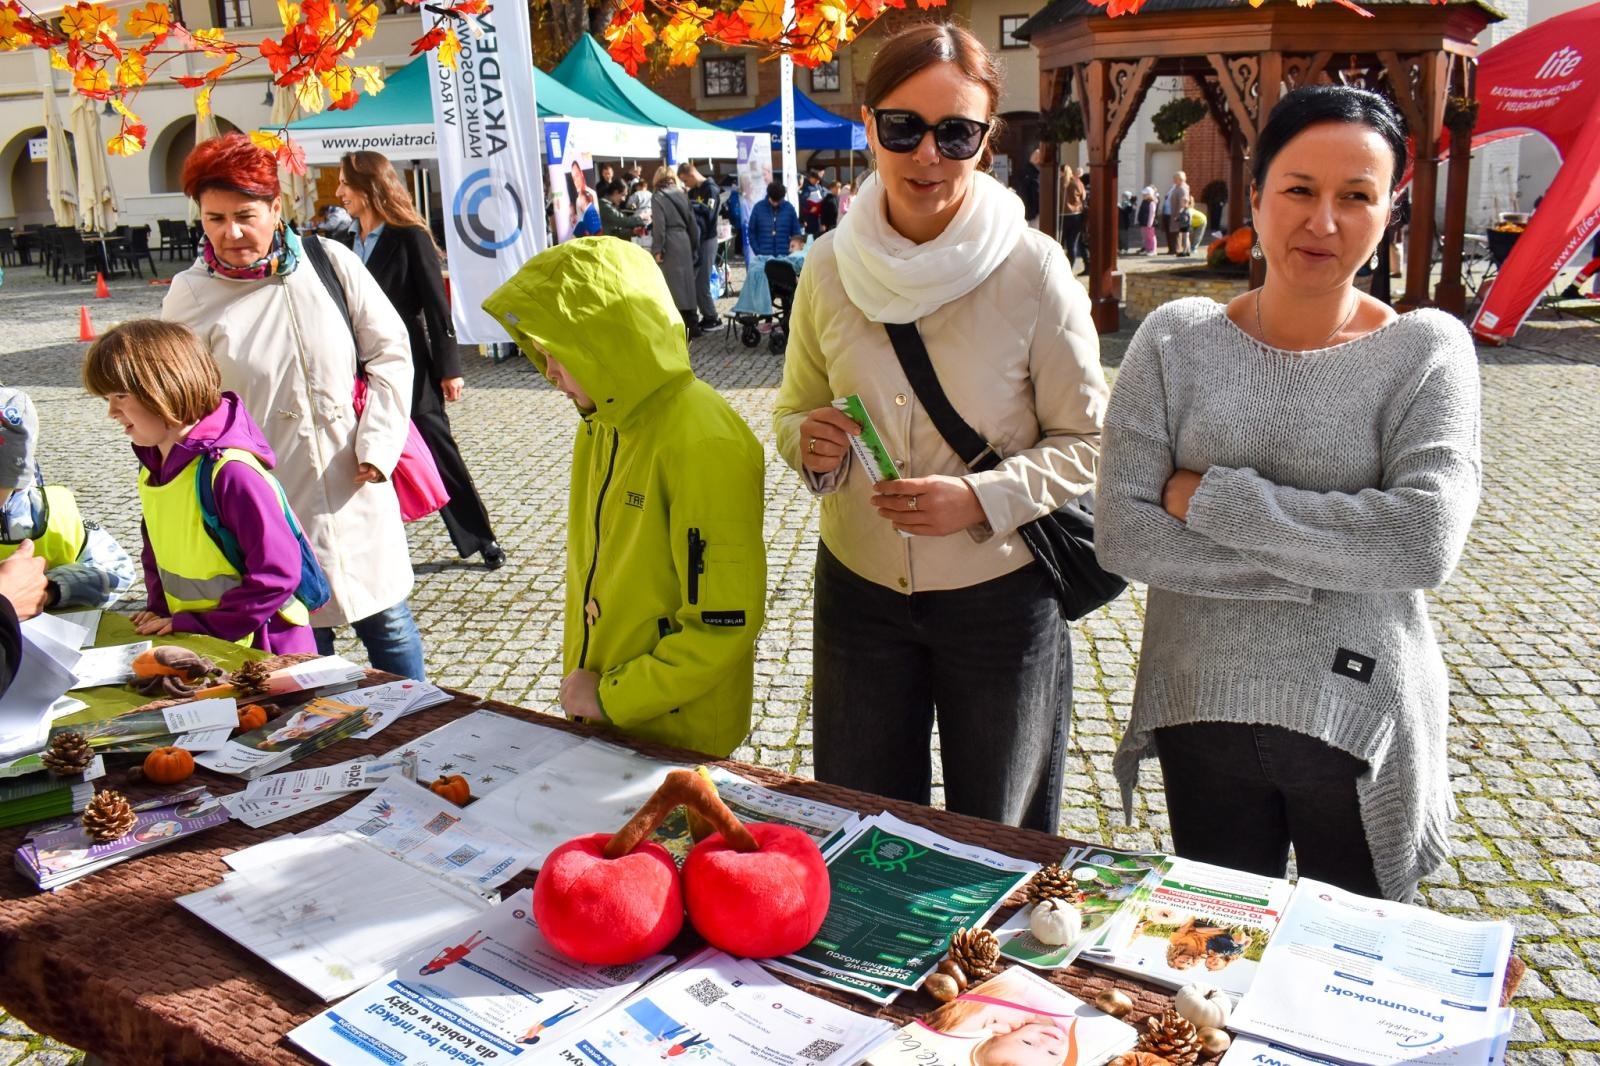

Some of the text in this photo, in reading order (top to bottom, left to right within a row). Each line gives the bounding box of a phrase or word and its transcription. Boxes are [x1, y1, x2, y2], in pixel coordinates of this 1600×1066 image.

[1534, 45, 1582, 79] life
[321, 131, 437, 150] www.powiatraci
[1150, 892, 1196, 906] CHOROB
[843, 962, 908, 980] KLESZCZOWE
[383, 995, 418, 1017] ciąży
[1323, 984, 1444, 1022] Pneumokoki
[363, 1000, 416, 1034] infekcji
[418, 1013, 432, 1025] w
[414, 1028, 438, 1047] bez
[430, 1019, 474, 1048] kobiet
[472, 1042, 497, 1060] dla
